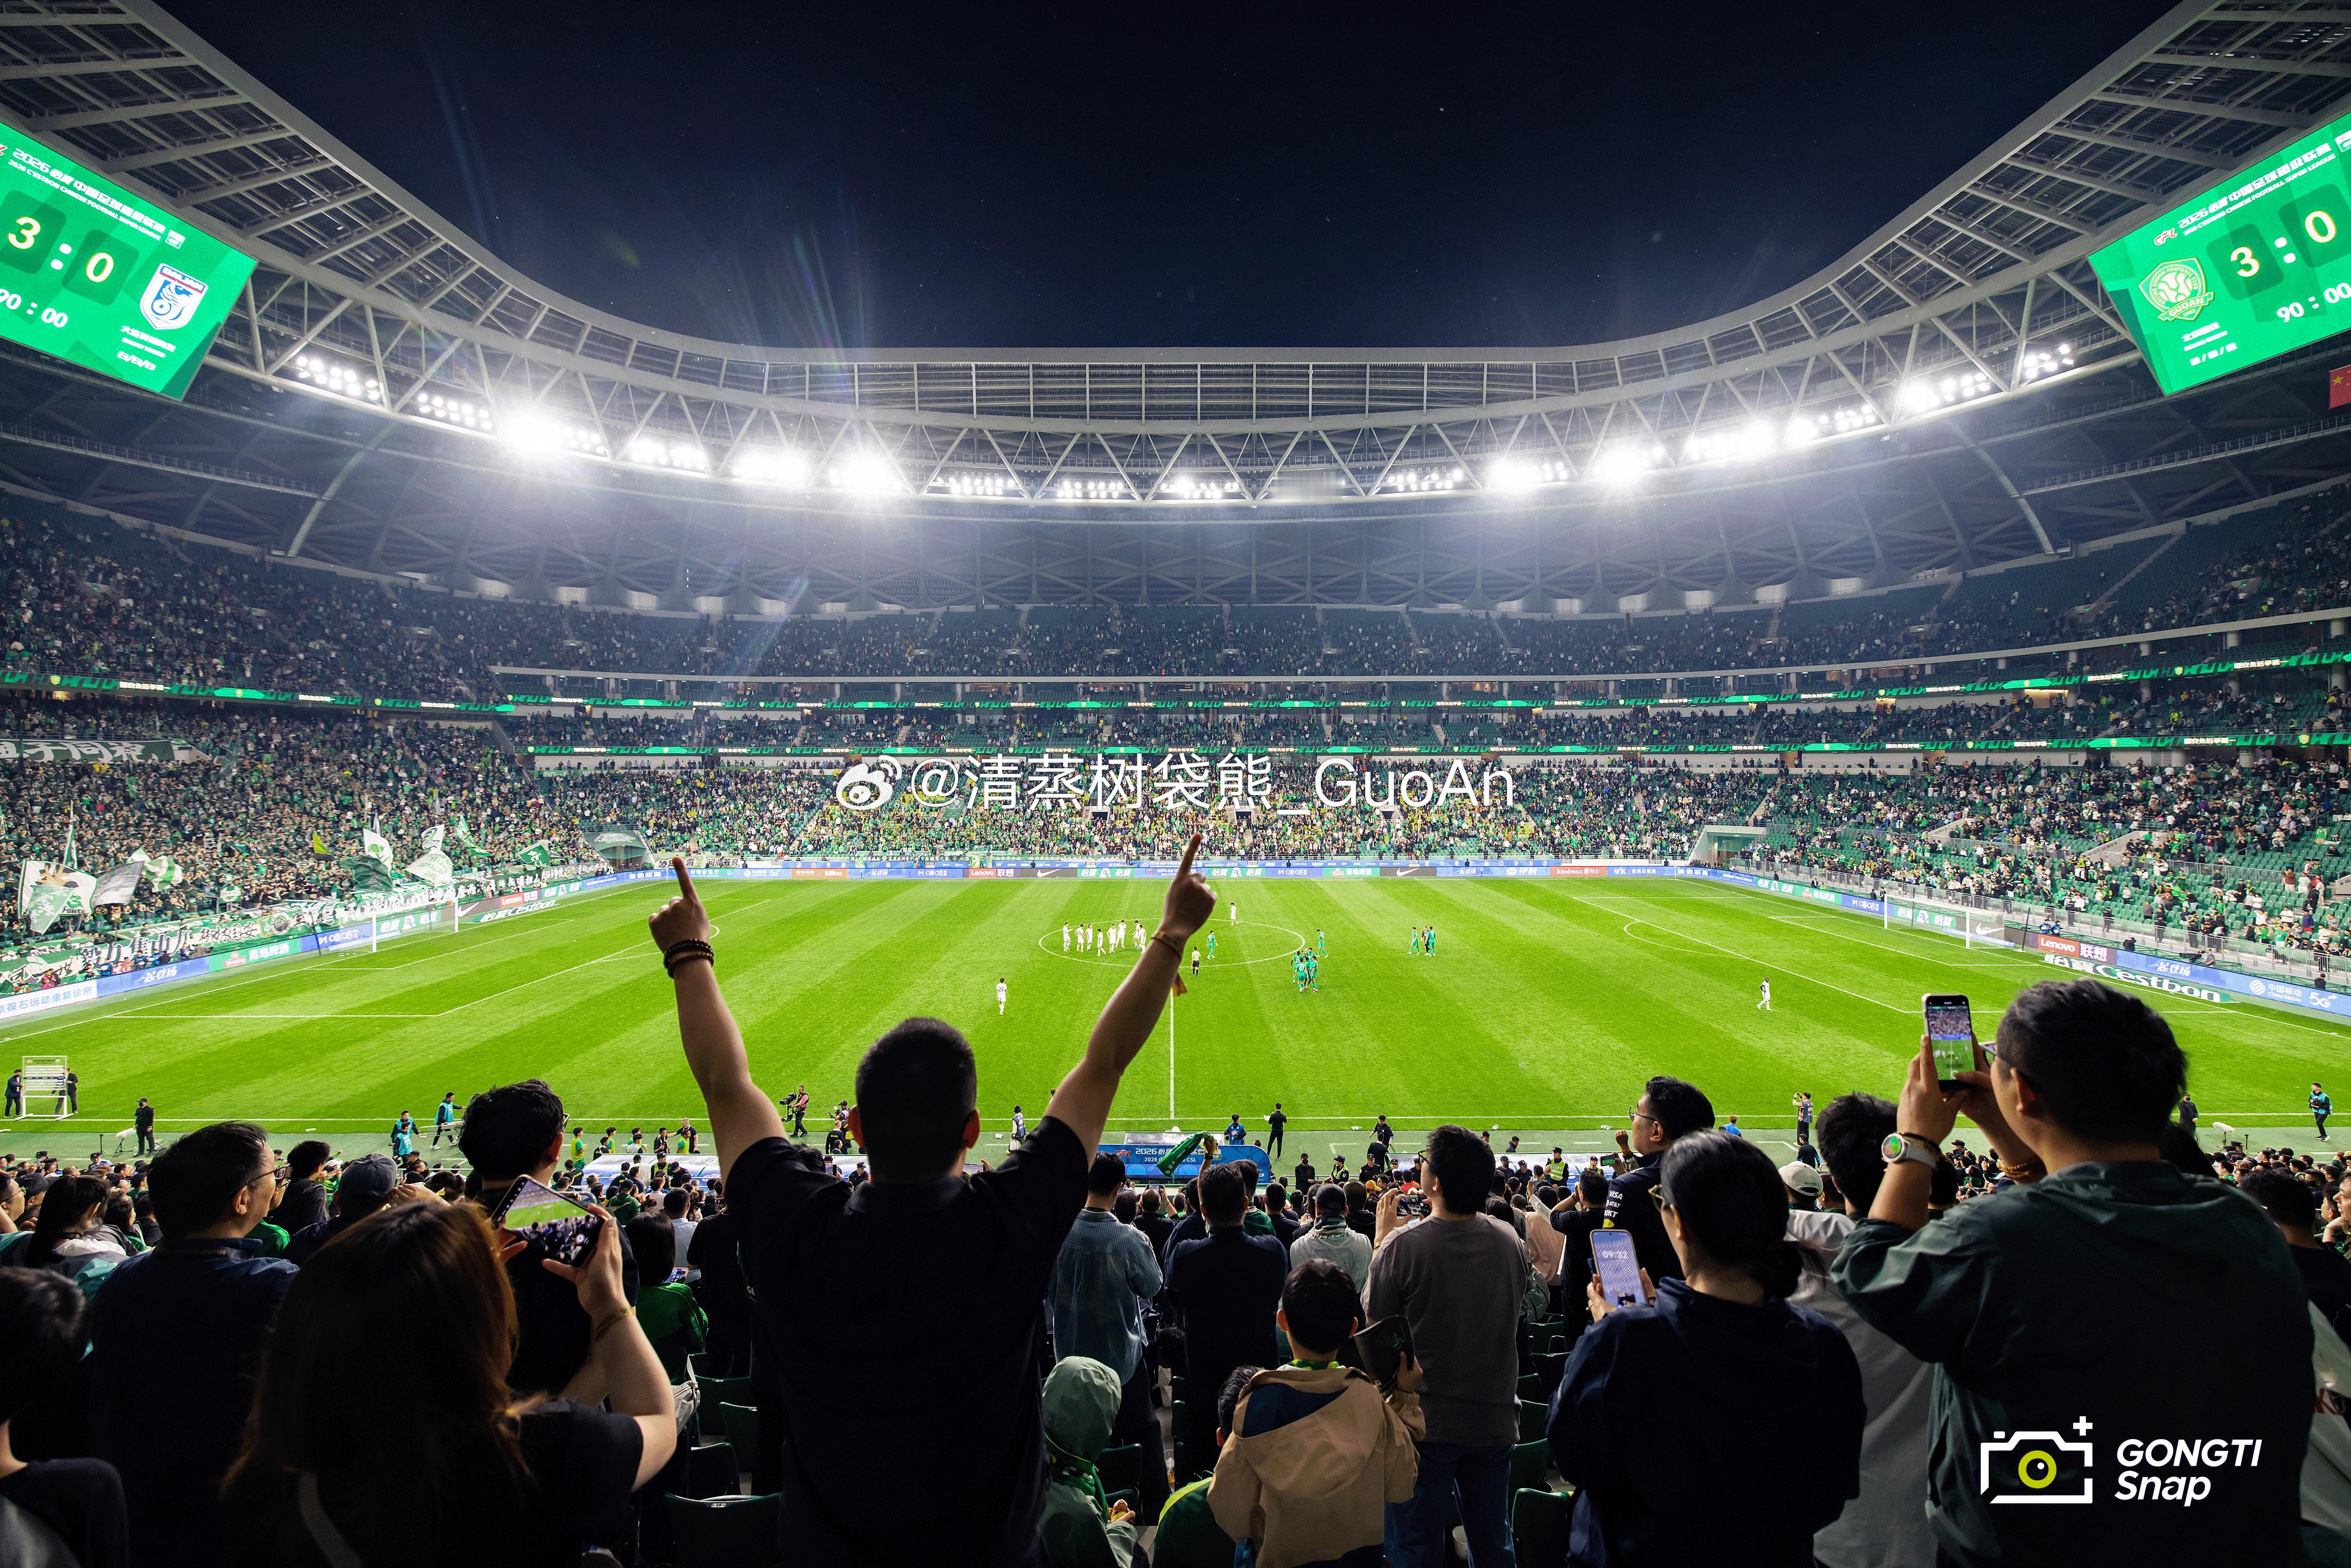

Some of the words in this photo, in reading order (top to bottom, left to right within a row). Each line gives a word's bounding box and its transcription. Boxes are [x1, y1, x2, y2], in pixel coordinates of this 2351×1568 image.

[13, 148, 51, 173] 2026
[2251, 180, 2286, 200] FOOTBALL
[2285, 168, 2308, 183] SUPER
[2307, 153, 2336, 172] LEAGUE
[8, 159, 27, 172] 2026
[87, 199, 119, 219] FOOTBALL
[2177, 207, 2209, 228] 2026
[2154, 227, 2178, 245] CFL
[2230, 246, 2261, 277] 3
[2304, 210, 2337, 243] 0
[7, 216, 41, 250] 3
[85, 252, 115, 283] 0
[162, 266, 204, 291] DALIAN
[2166, 267, 2193, 277] FOOTBALL
[2169, 297, 2205, 317] GUOAN
[2277, 301, 2305, 322] 90
[2323, 283, 2351, 305] 00
[41, 307, 68, 328] 00
[658, 857, 695, 868] 凌霄
[997, 869, 1014, 877] 联想
[2040, 938, 2076, 953] Lenovo
[2079, 943, 2108, 962] 联想
[134, 966, 178, 984] 一起登场
[2148, 962, 2191, 976] 一起登场
[2268, 984, 2302, 997] 中国移动
[1115, 1150, 1131, 1159] CFL
[1609, 1190, 1623, 1200] VISA
